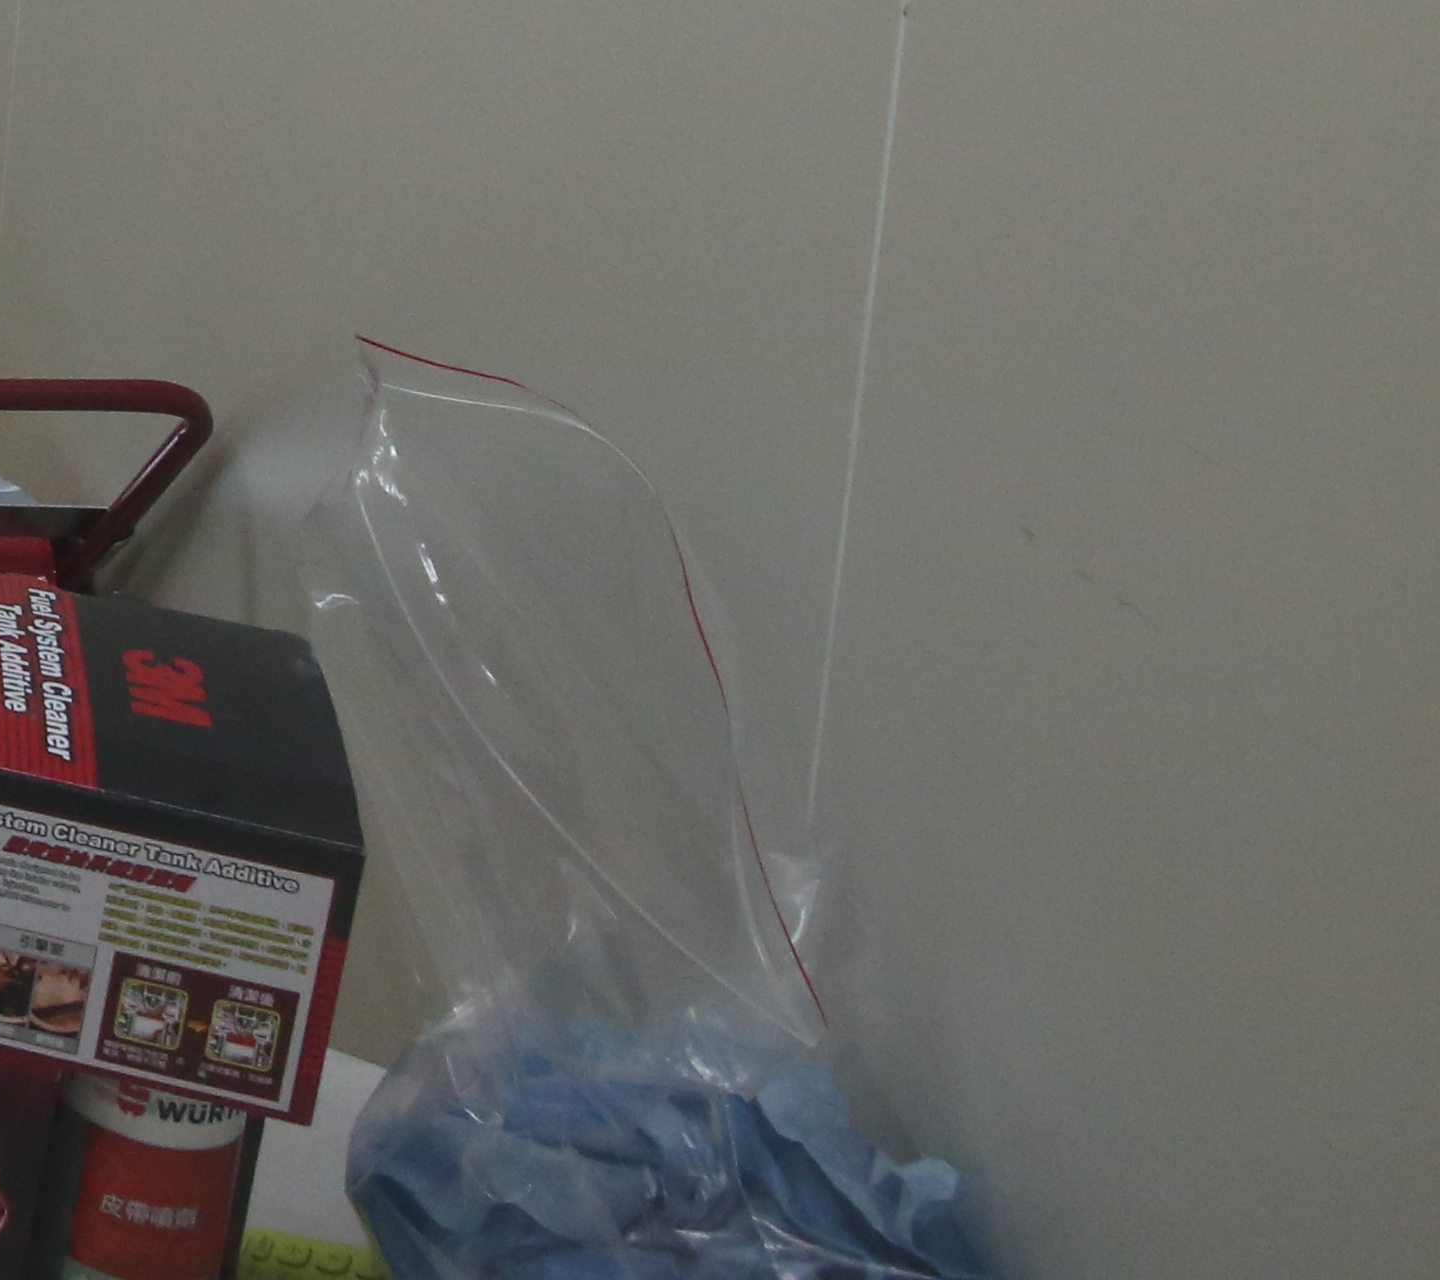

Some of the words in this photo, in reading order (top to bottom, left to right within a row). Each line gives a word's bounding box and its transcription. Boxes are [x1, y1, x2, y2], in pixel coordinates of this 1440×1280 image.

[27, 587, 60, 620] Fuel
[0, 635, 33, 714] Additive
[31, 618, 64, 678] System
[41, 680, 73, 762] Cleaner
[121, 648, 213, 727] 3M
[52, 822, 141, 859] Cleaner
[144, 842, 202, 873] Tank
[203, 858, 300, 894] Additive
[157, 1098, 240, 1124] WÜR
